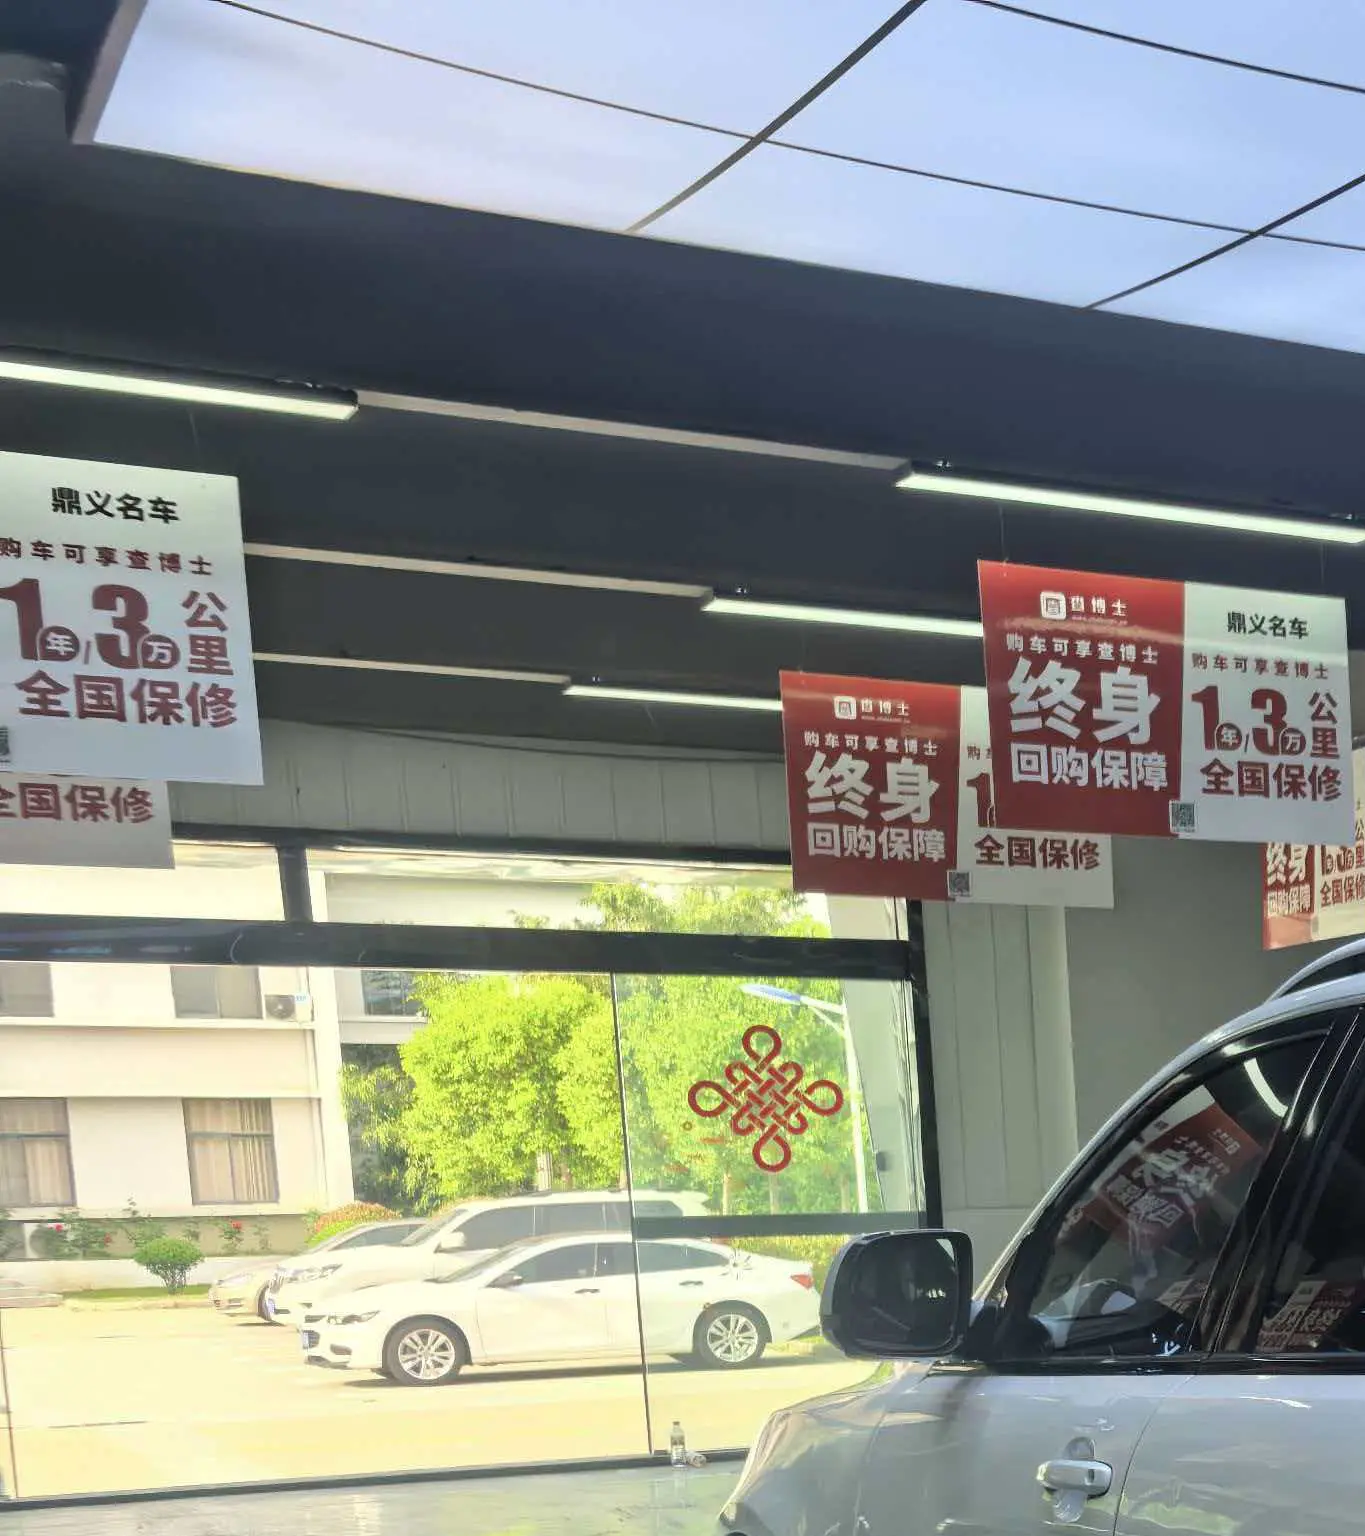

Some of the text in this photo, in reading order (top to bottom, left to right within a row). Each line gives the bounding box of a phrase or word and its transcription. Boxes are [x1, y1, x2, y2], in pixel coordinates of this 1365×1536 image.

[51, 486, 180, 524] 鼎义名车
[0, 537, 213, 576] 购车可享查博士
[1227, 611, 1309, 639] 鼎义名车
[1006, 633, 1159, 665] 购车可享查博士
[1191, 652, 1330, 680] 购车可享查博士
[14, 670, 239, 728] 全国保修
[1007, 657, 1161, 745] 终身
[804, 731, 938, 757] 购车可享查博士
[1010, 743, 1168, 791] 回购保障
[1200, 758, 1343, 801] 全国保修
[805, 751, 940, 824] 终身
[807, 823, 946, 863] 回购保障
[974, 834, 1100, 871] 全国保修
